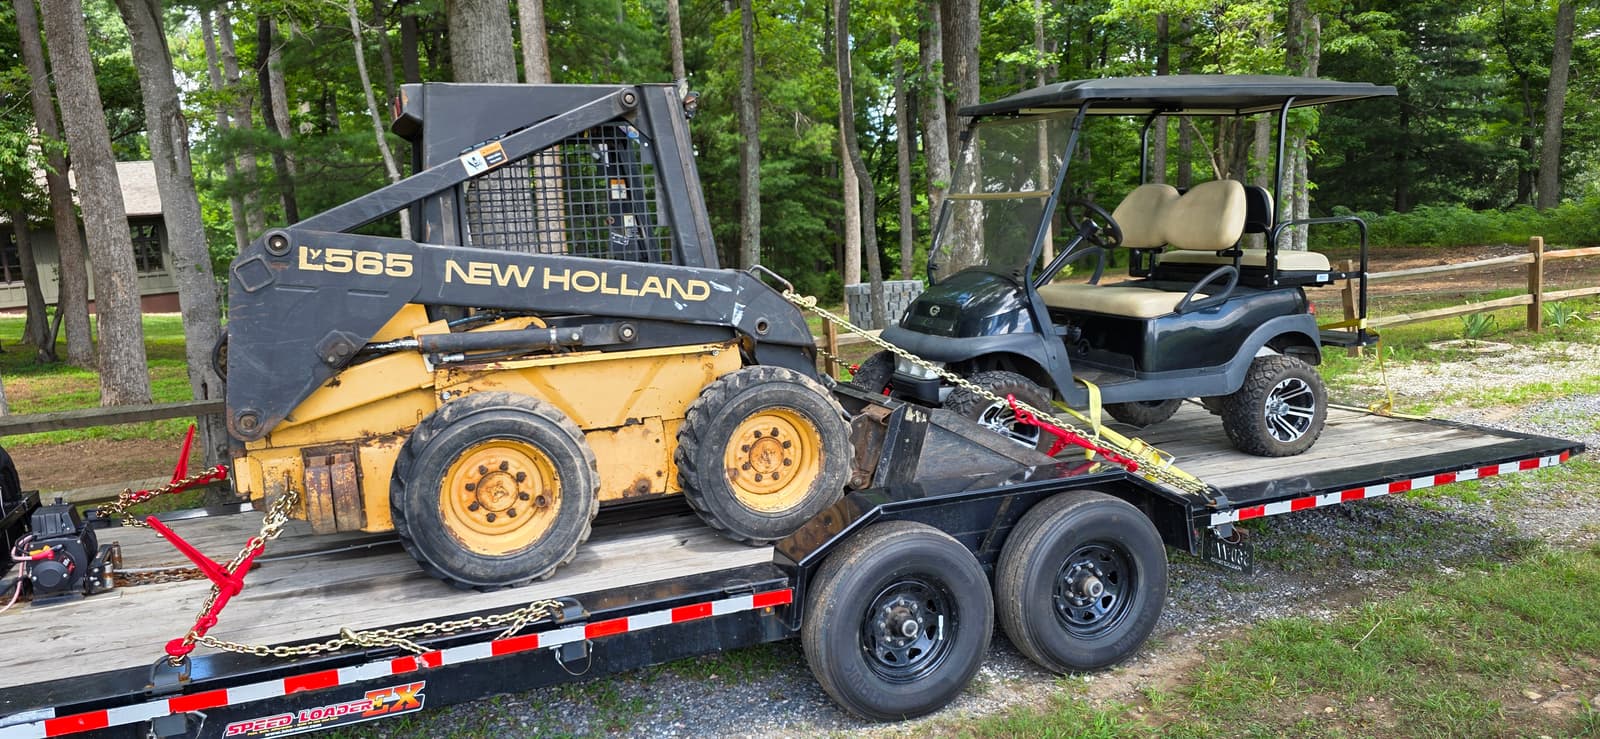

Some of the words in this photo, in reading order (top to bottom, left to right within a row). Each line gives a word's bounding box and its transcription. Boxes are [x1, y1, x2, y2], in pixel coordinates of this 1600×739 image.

[444, 259, 535, 289] NEW
[543, 267, 711, 302] HOLLAND
[226, 714, 292, 736] SPEED
[299, 699, 374, 722] LOADER
[362, 682, 424, 717] EX
